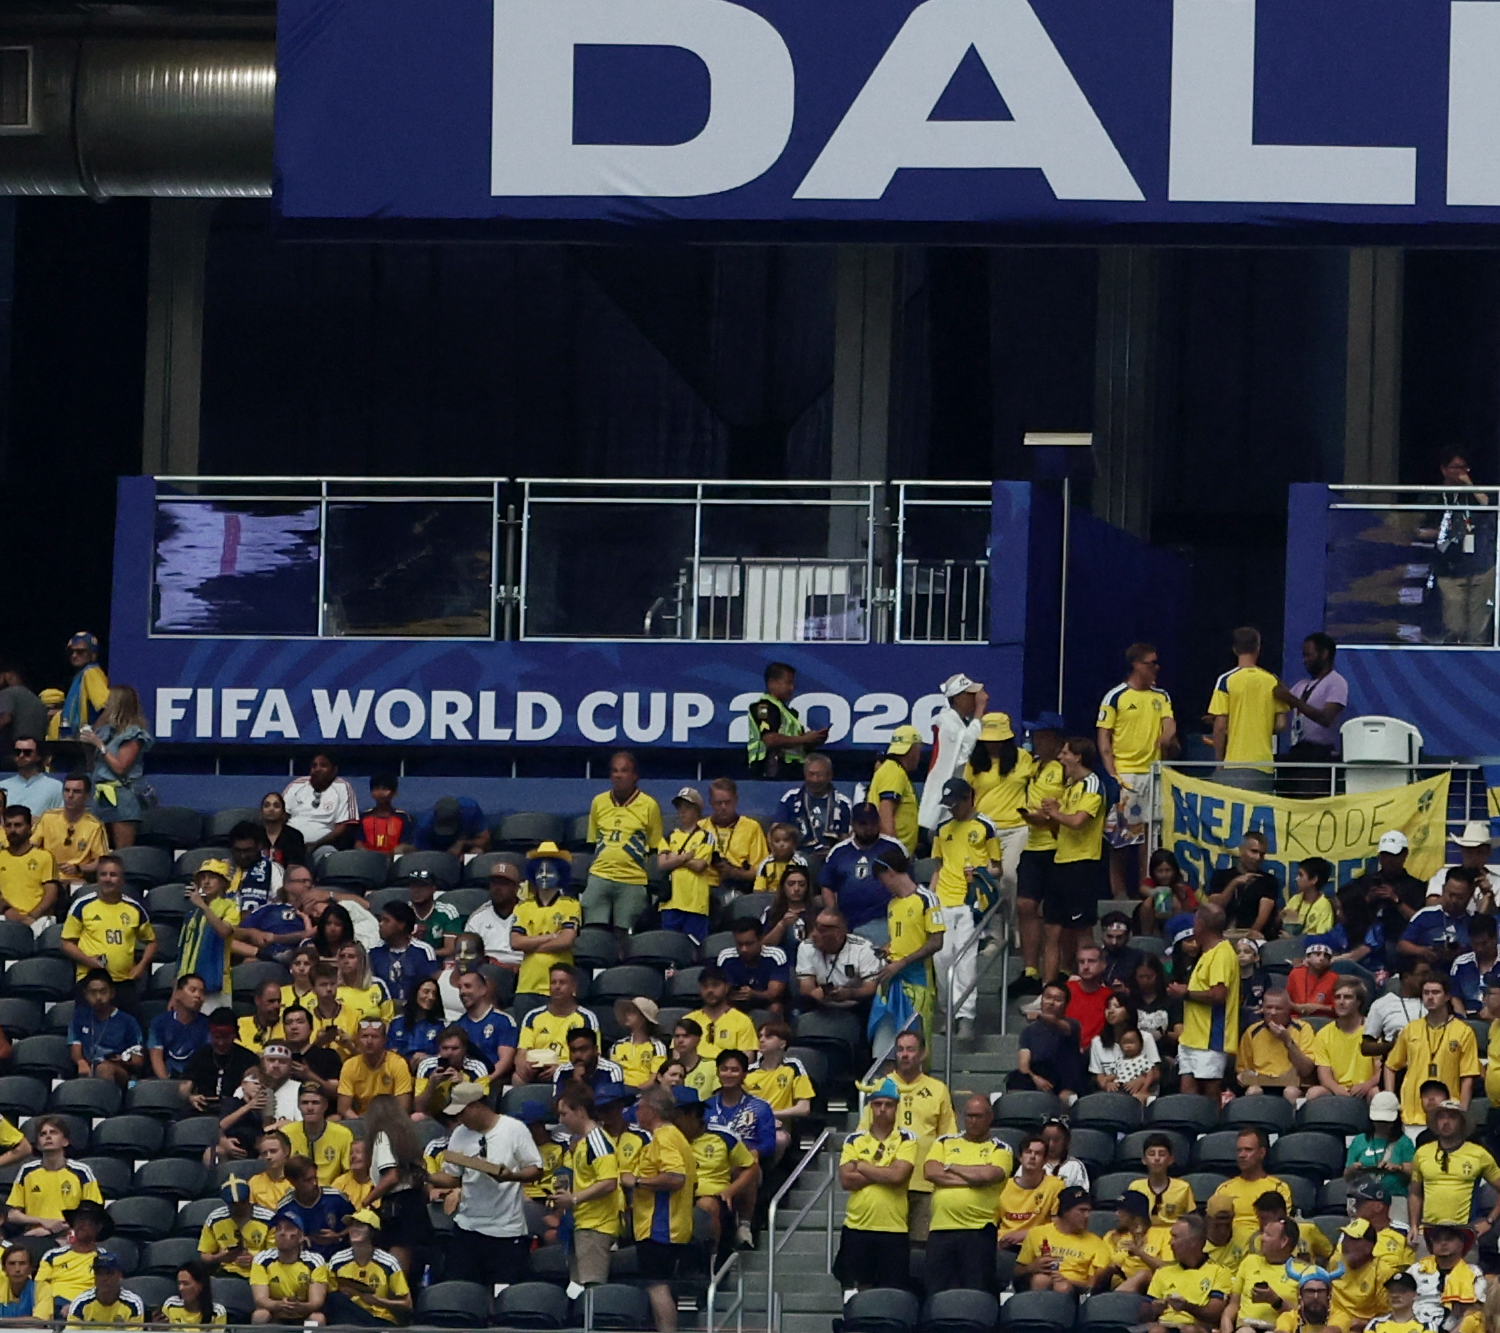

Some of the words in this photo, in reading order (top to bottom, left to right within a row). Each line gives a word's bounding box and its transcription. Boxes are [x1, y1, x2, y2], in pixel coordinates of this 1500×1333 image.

[155, 687, 301, 738] FIFA
[312, 688, 563, 742] WORLD
[577, 691, 715, 744] CUP
[1284, 799, 1395, 855] KODE
[904, 1110, 912, 1126] 9
